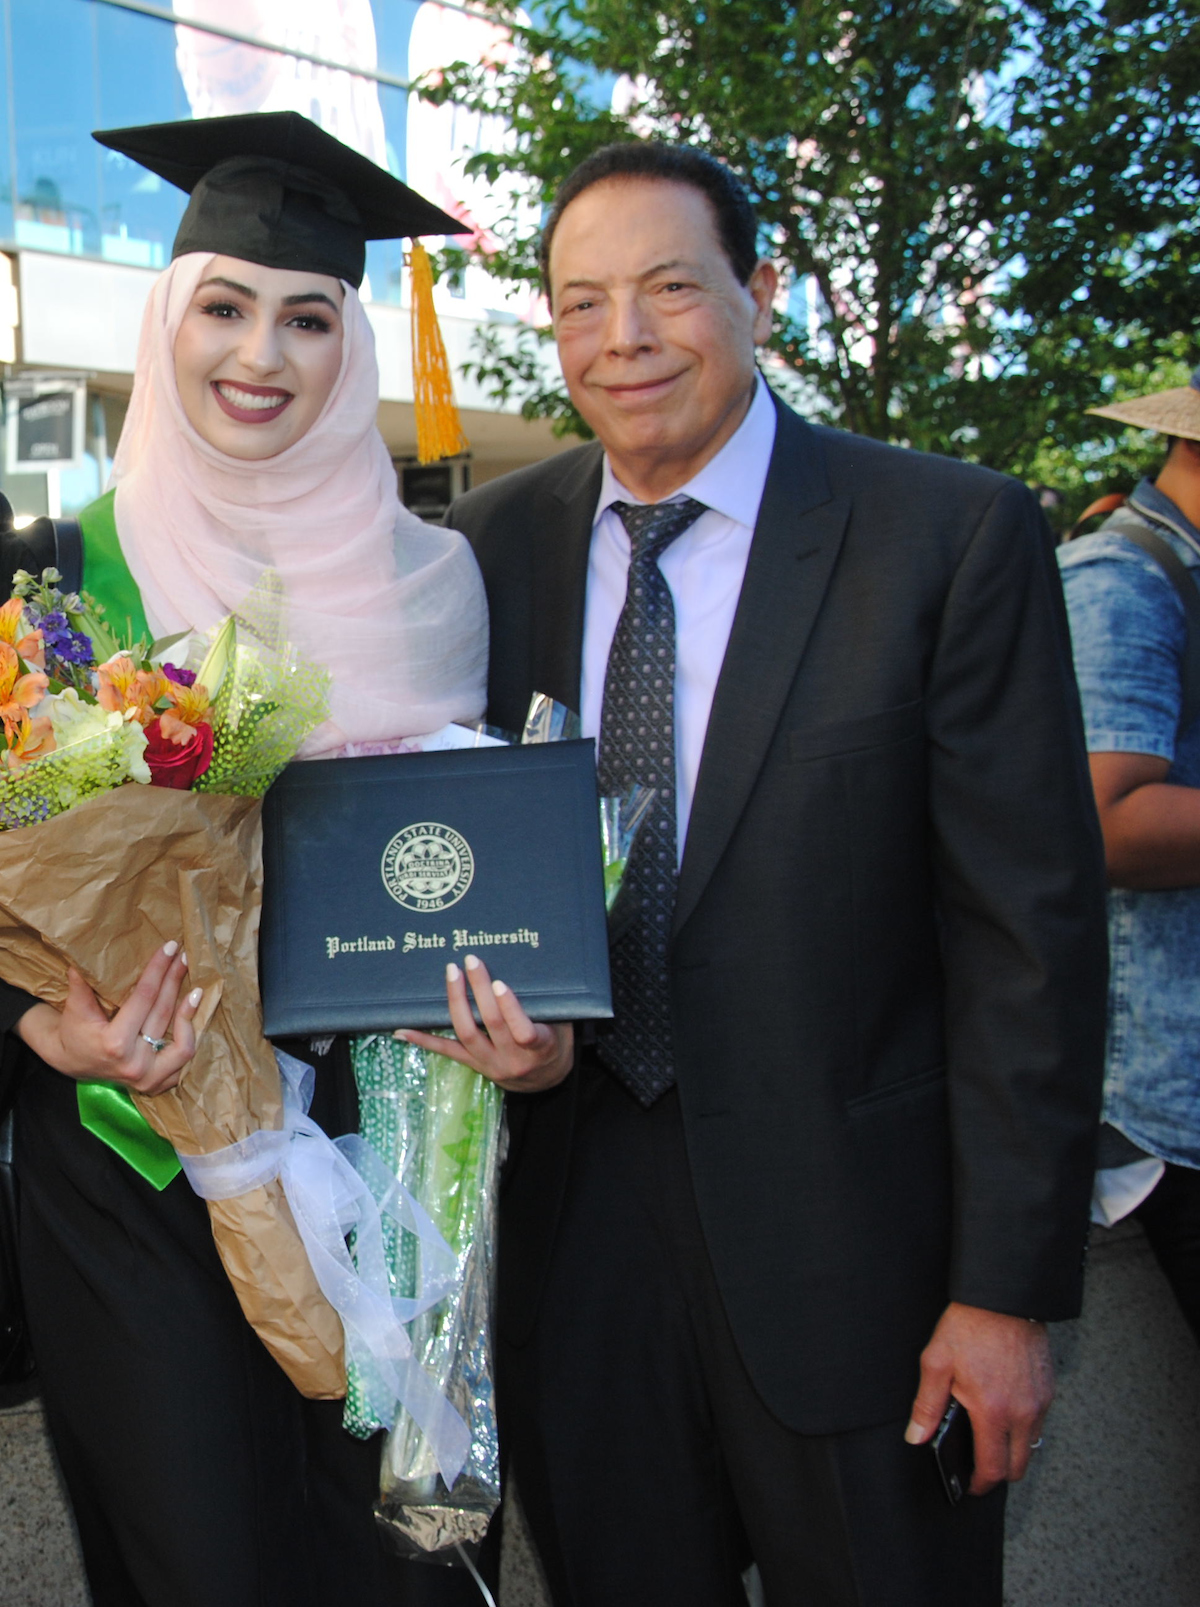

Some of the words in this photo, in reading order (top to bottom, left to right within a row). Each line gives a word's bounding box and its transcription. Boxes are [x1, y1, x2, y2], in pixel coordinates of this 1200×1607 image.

[385, 839, 409, 901] PORTLAND
[403, 826, 443, 840] STATE
[445, 831, 471, 897] UNIVERSITY
[416, 898, 445, 910] 1946
[326, 936, 396, 959] Portland
[402, 932, 446, 953] State
[452, 928, 539, 951] University
